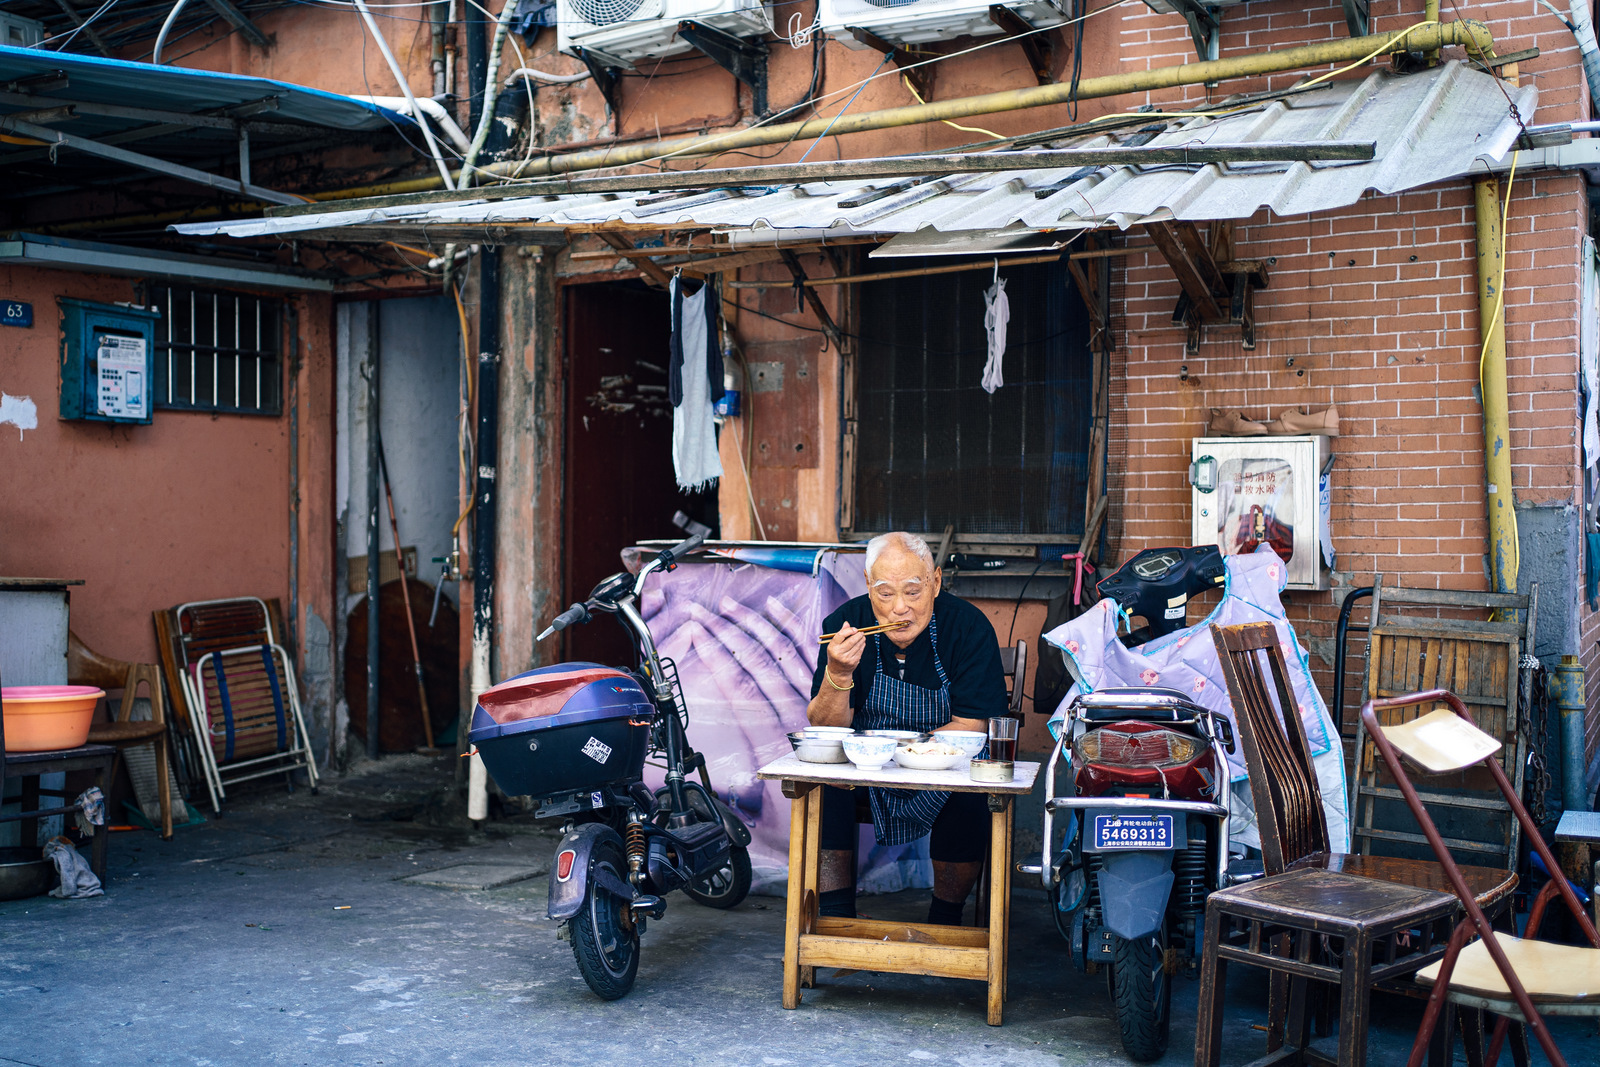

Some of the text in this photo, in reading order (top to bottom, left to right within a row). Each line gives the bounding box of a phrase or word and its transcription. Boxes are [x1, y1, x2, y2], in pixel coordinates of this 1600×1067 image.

[7, 304, 23, 317] 63
[1103, 819, 1122, 827] 上海
[1102, 828, 1167, 840] 5469313
